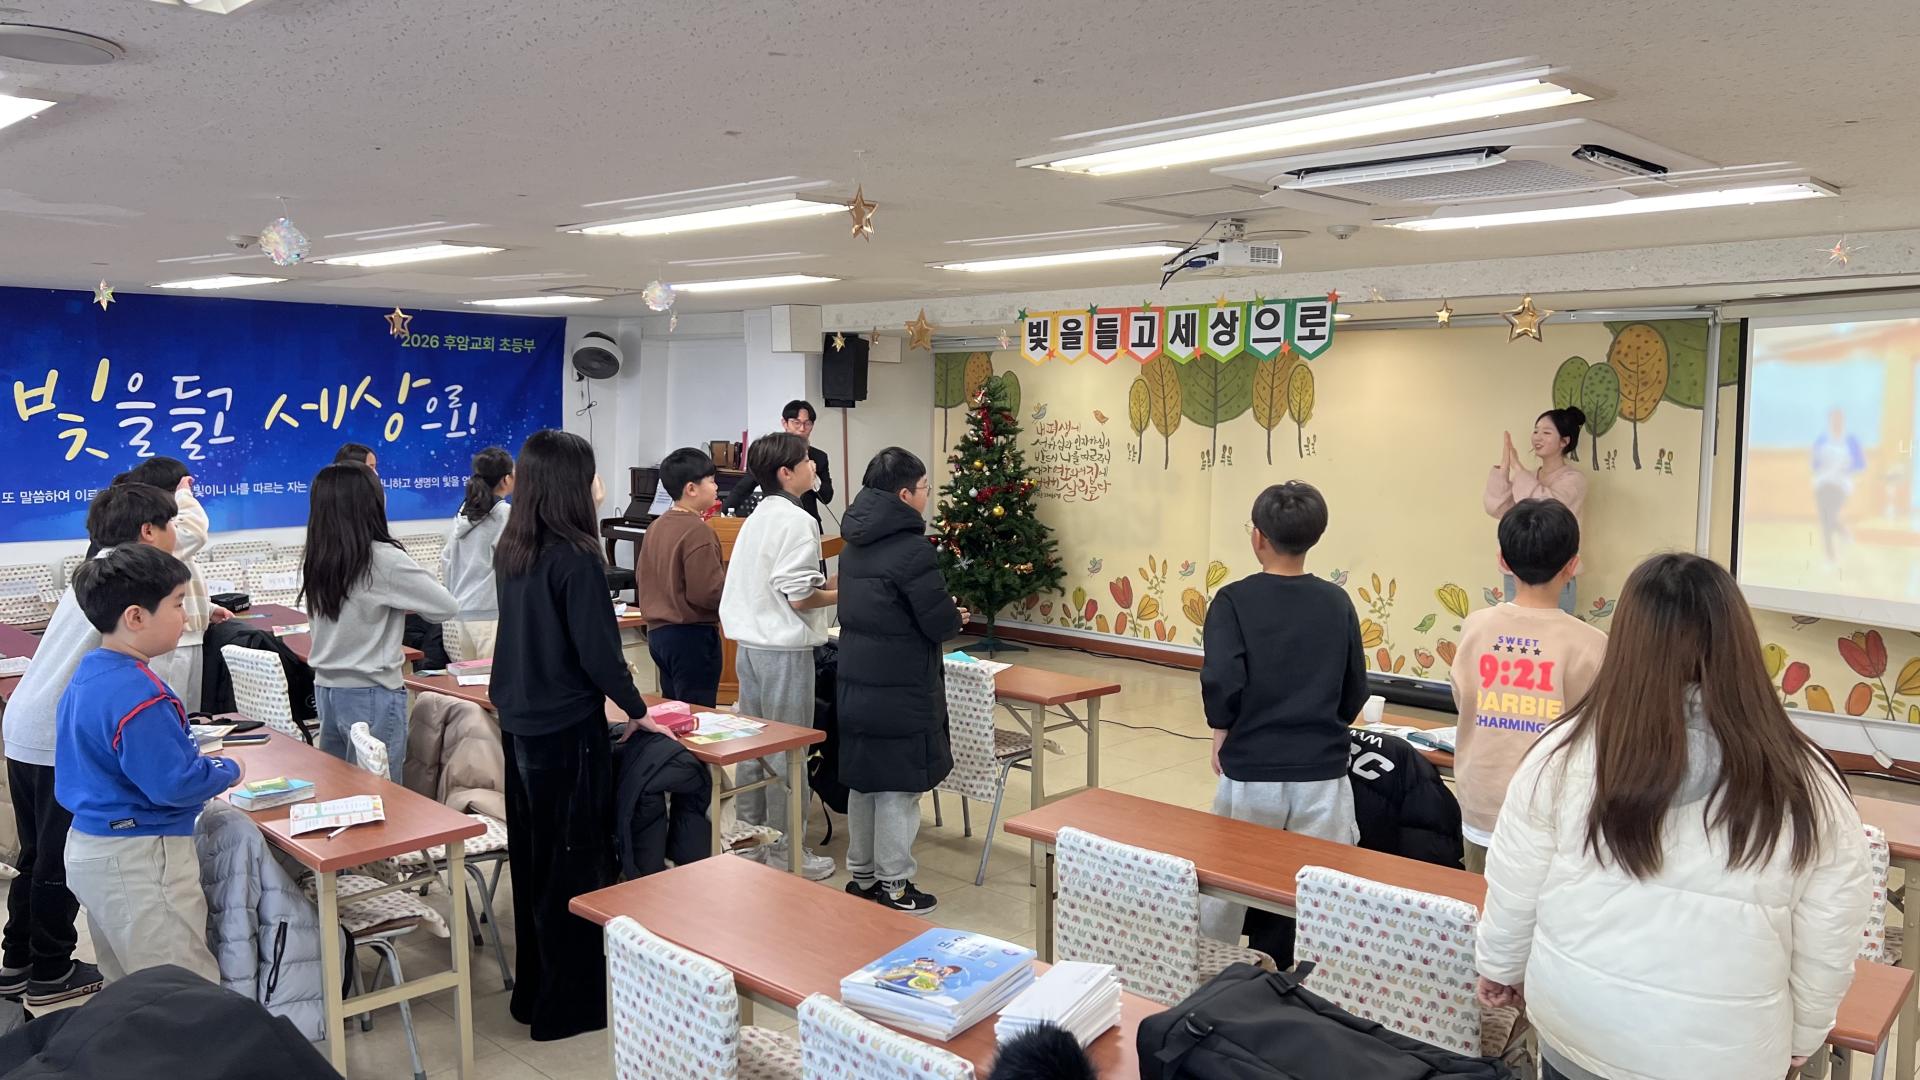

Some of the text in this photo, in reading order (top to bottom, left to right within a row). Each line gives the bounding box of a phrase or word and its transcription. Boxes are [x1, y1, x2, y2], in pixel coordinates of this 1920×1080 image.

[401, 334, 537, 353] 2026 후암교회 초등부
[264, 372, 478, 442] 세상으로!
[2, 490, 16, 503] 또
[20, 489, 70, 504] 말씀하여
[193, 483, 227, 498] 빛이니
[230, 483, 250, 496] 나를
[253, 482, 284, 495] 따르는
[287, 481, 308, 494] 자는
[413, 476, 440, 489] 생명의
[443, 475, 459, 487] 빛을
[1498, 635, 1539, 647] SWEET
[1480, 654, 1555, 692] 9:21
